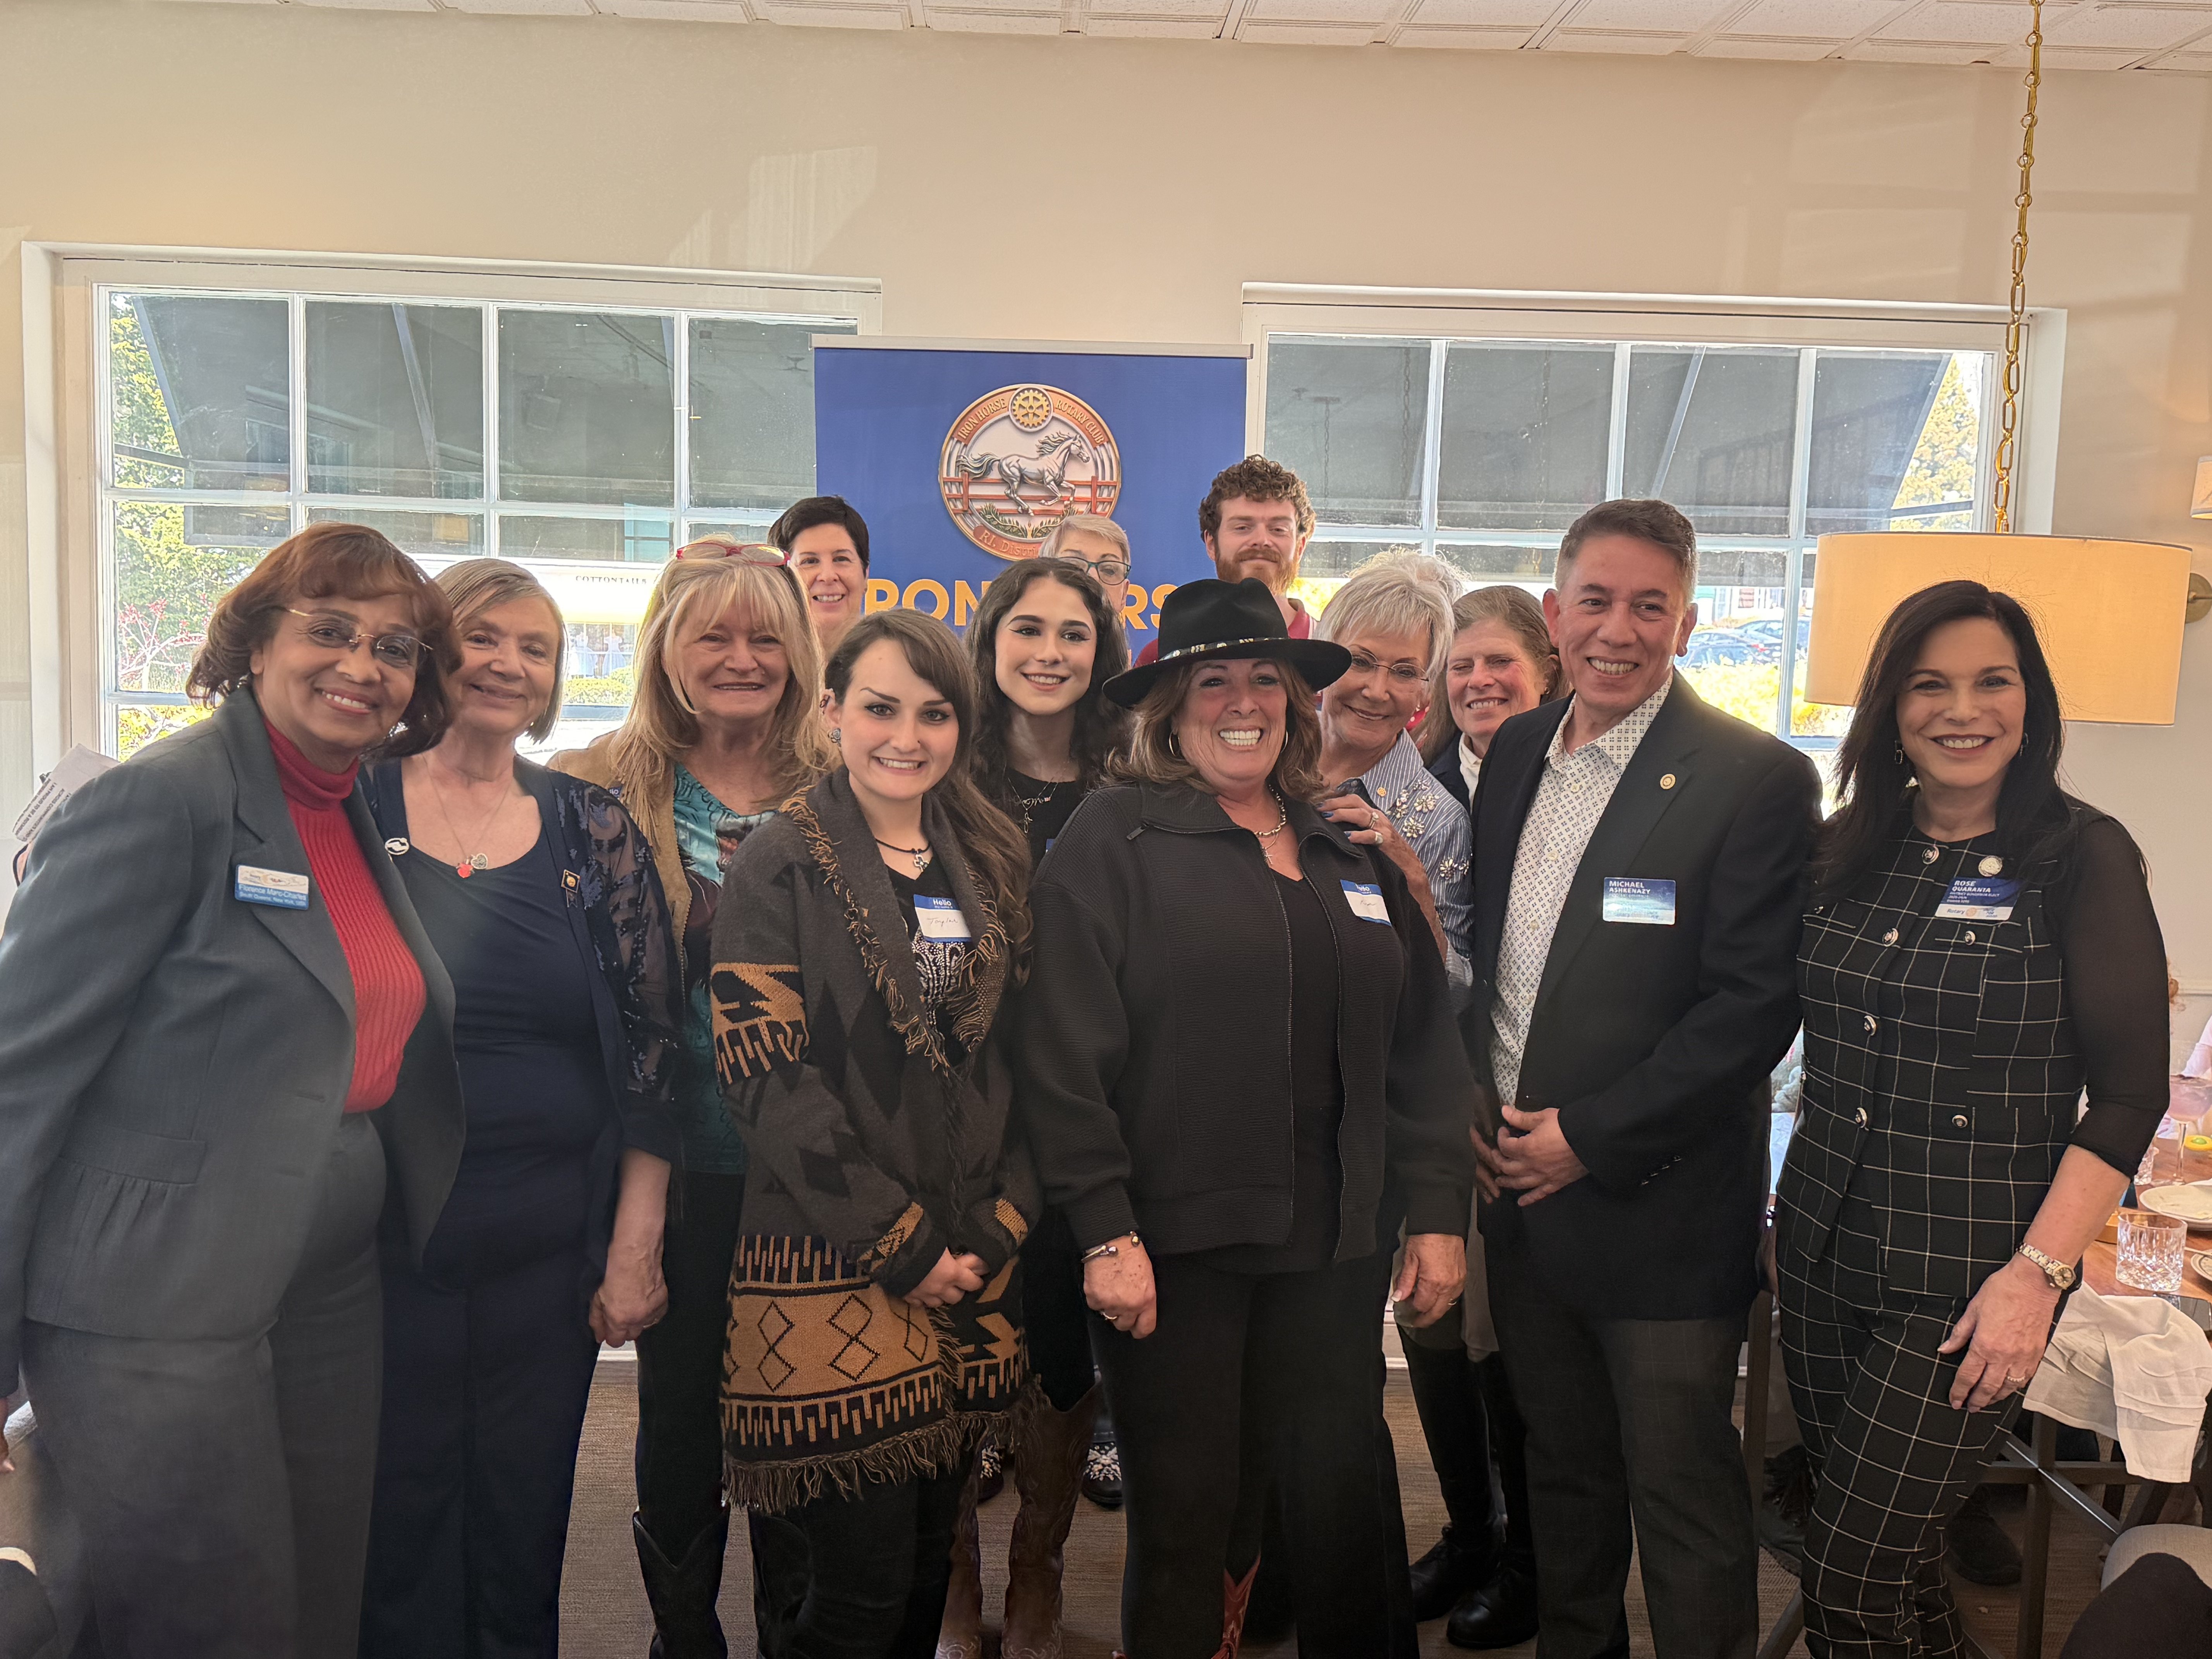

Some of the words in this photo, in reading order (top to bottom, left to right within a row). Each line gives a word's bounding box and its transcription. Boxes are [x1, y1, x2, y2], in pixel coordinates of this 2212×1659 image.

[957, 416, 979, 439] IRON
[975, 398, 1007, 421] HORSE
[1055, 398, 1090, 424] ROTARY
[1085, 422, 1105, 443] CLUB
[1000, 540, 1036, 556] Distri
[576, 575, 646, 584] COTTONTAILS
